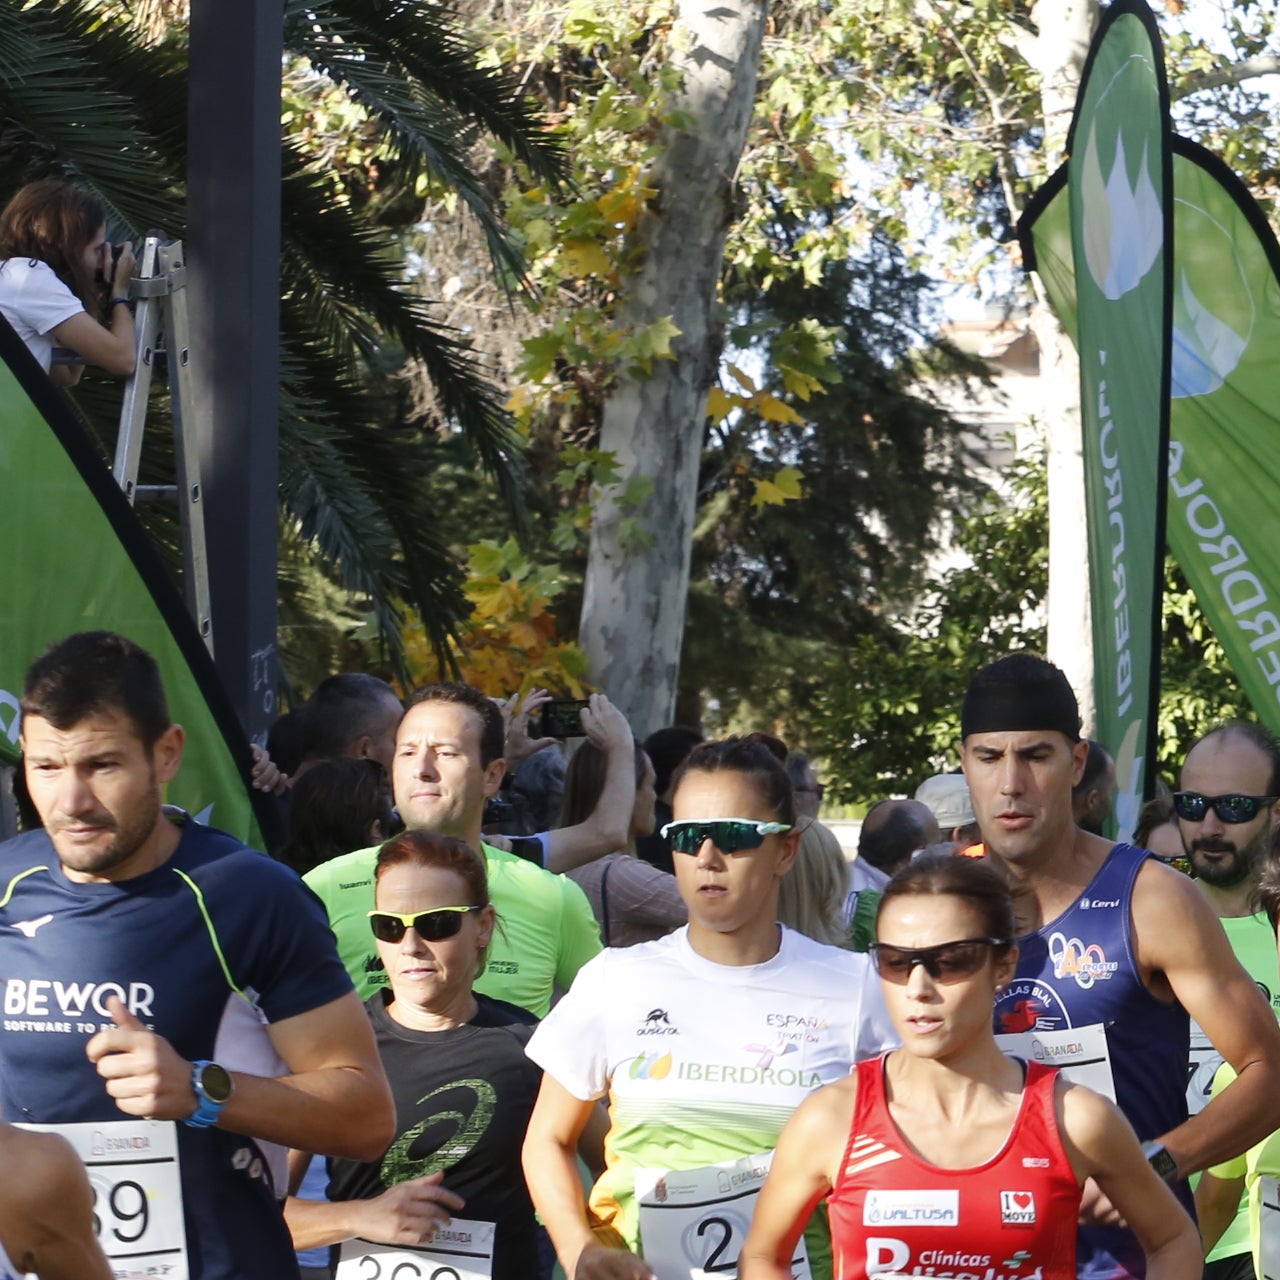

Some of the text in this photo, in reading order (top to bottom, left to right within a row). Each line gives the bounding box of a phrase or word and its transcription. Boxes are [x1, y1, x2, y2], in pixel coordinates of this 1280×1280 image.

[4, 979, 154, 1017] BEWOR
[3, 1020, 72, 1033] SOFTWARE
[77, 1022, 96, 1034] TO
[766, 1013, 829, 1029] ESPAÑA
[1044, 1043, 1084, 1056] GRANADA
[677, 1062, 825, 1088] IBERDROLA
[919, 1249, 991, 1267] Clínicas
